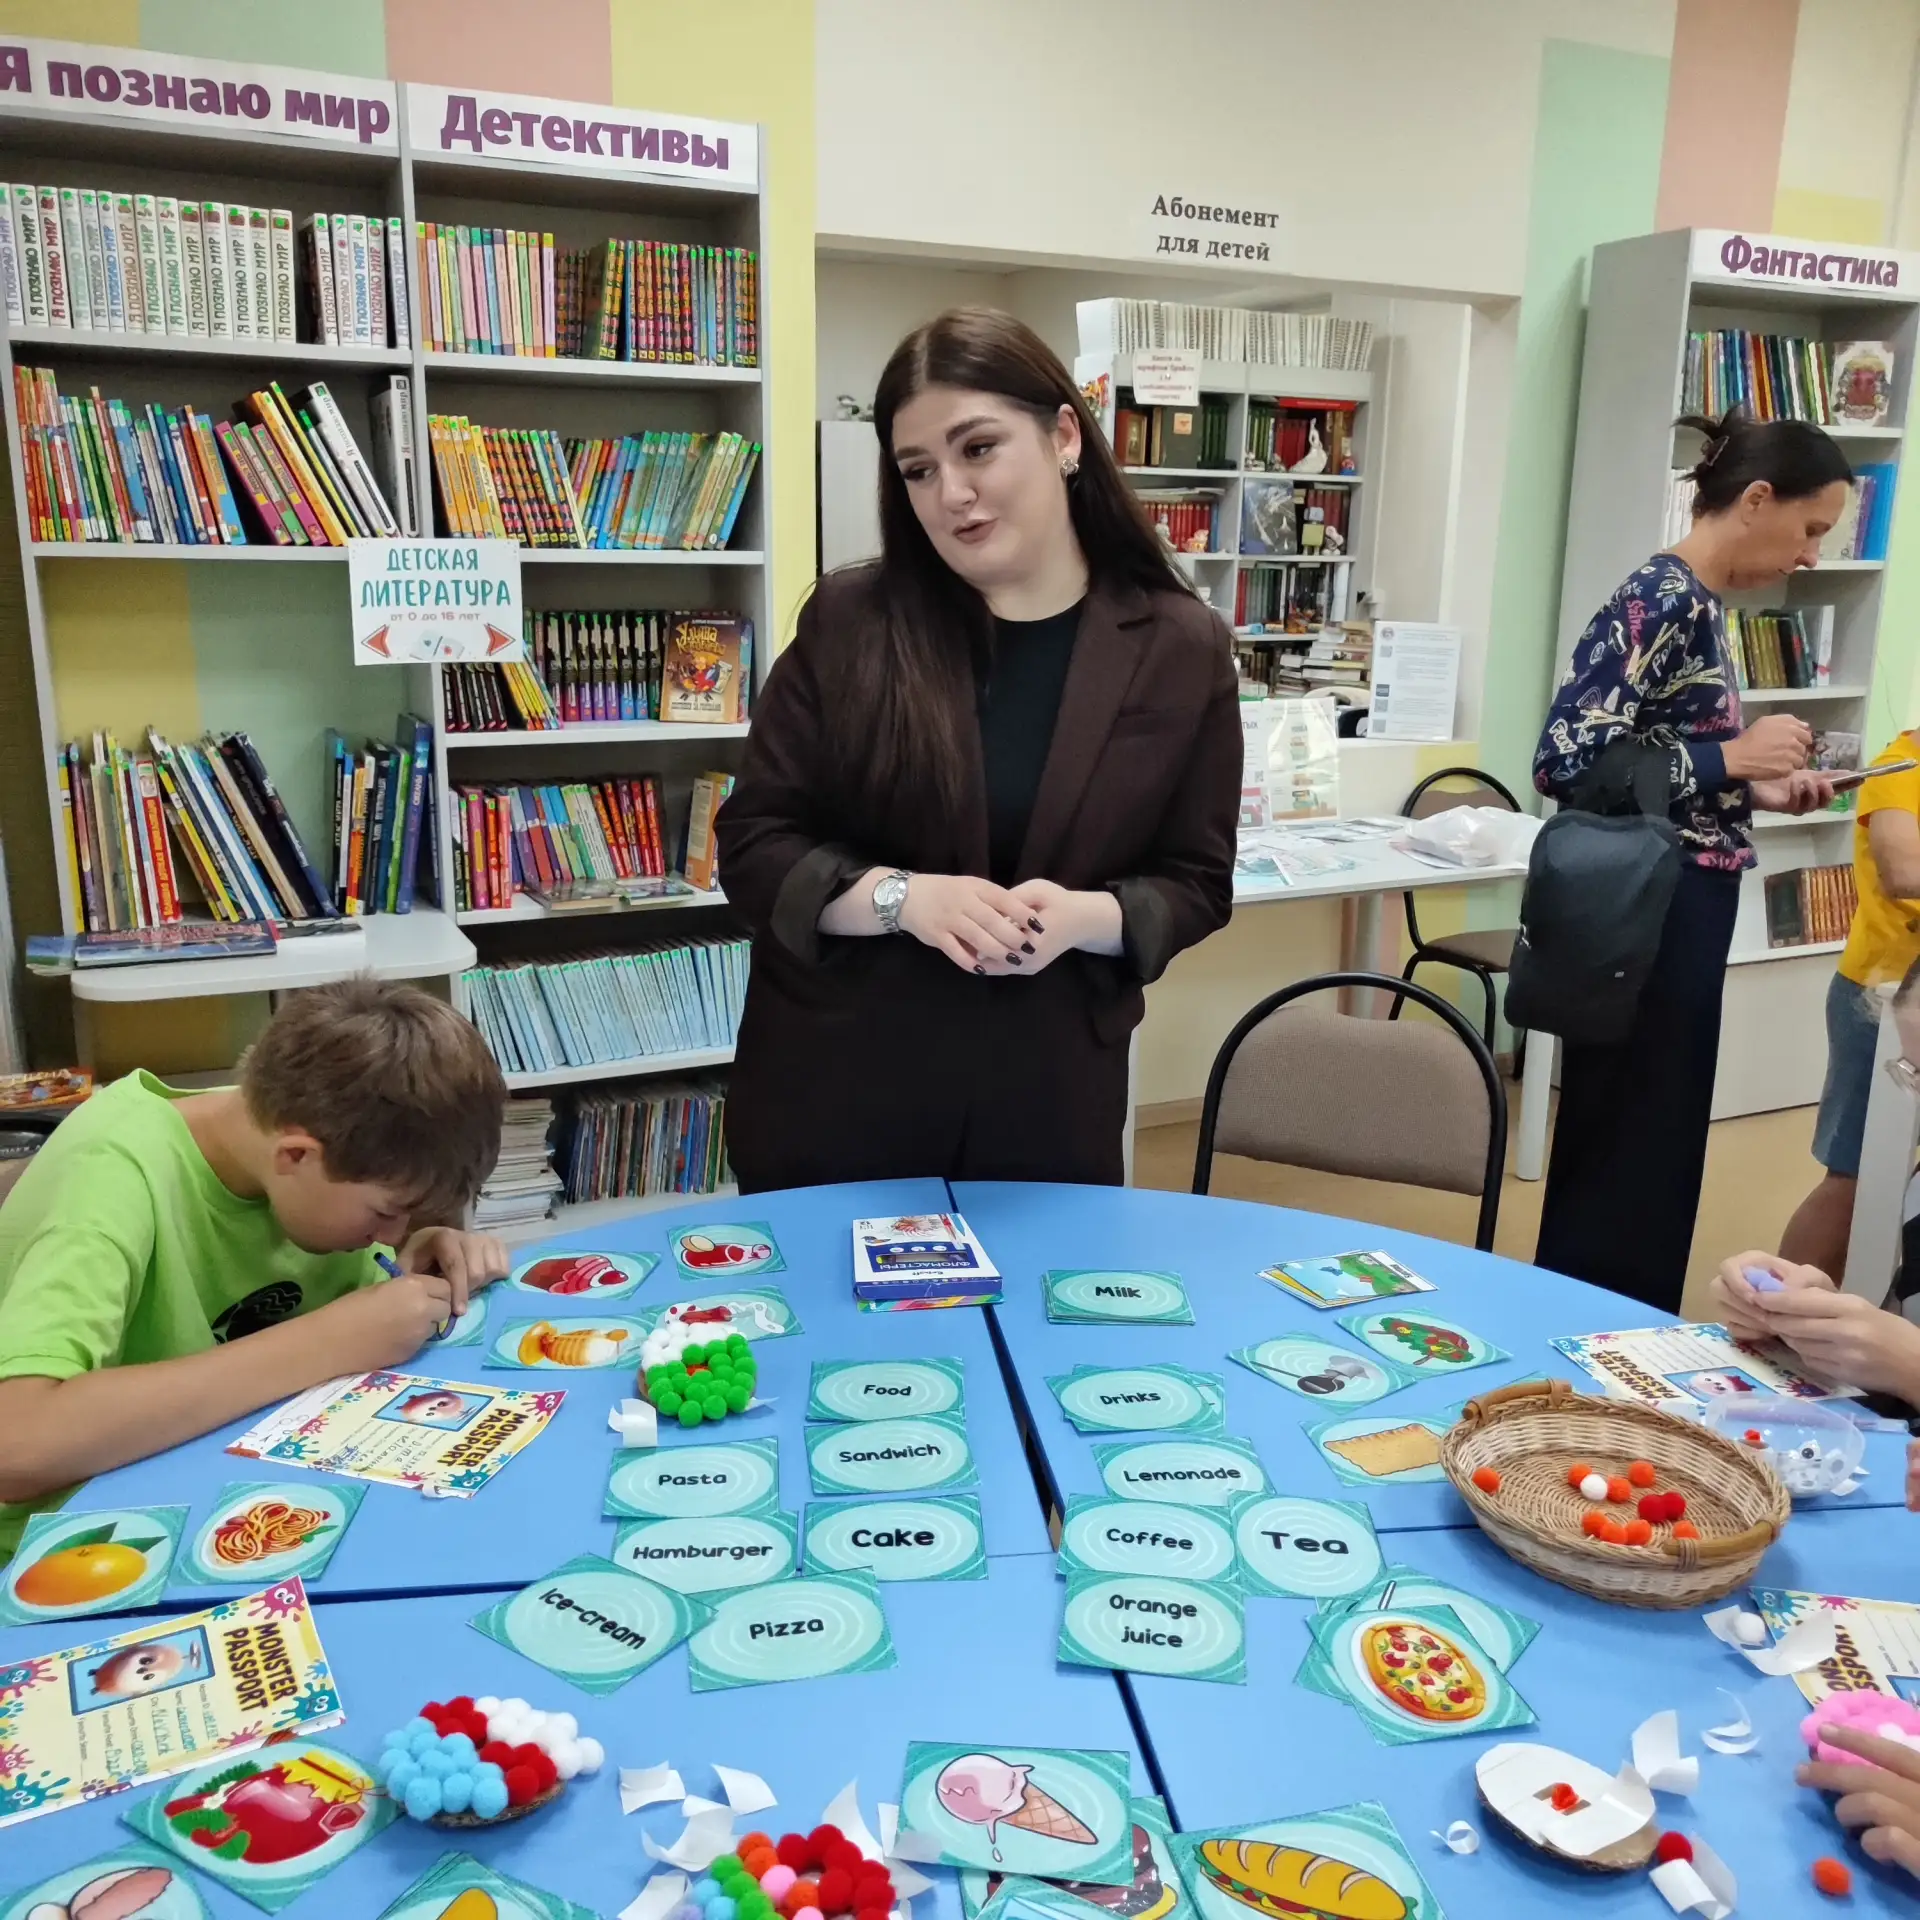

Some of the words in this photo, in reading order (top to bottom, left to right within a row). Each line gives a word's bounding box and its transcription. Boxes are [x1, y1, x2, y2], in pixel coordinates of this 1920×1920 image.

[0, 45, 30, 93] Я
[48, 61, 271, 120] познаю
[285, 86, 391, 144] мир
[440, 95, 730, 171] Детективы
[1151, 194, 1279, 230] Абонемент
[1156, 233, 1199, 255] для
[1206, 240, 1270, 261] детей
[1720, 234, 1899, 288] Фантастика
[189, 266, 205, 318] ПОЗНАЮ
[211, 267, 225, 319] ПОЗНАЮ
[235, 270, 250, 322] ПОЗНАЮ
[255, 272, 269, 323] ПОЗНАЮ
[277, 273, 291, 324] ПОЗНАЮ
[52, 308, 65, 319] Я
[191, 321, 205, 331] Я
[213, 322, 227, 332] Я
[237, 324, 251, 334] Я
[257, 325, 270, 335] Я
[279, 326, 291, 336] Я
[387, 548, 479, 571] ДЕТСКАЯ
[361, 579, 511, 608] ЛИТЕРАТУРА
[391, 614, 403, 622] от
[422, 613, 437, 621] до
[458, 612, 480, 621] лет
[1095, 1286, 1142, 1300] Milk
[1590, 1352, 1661, 1399] MONSTER
[1602, 1349, 1681, 1399] PASSPORT
[863, 1383, 912, 1398] Food
[1099, 1389, 1161, 1407] Drinks
[436, 1408, 511, 1467] PASSPORT
[465, 1412, 529, 1469] MONSTER
[839, 1444, 941, 1464] Sandwich
[657, 1472, 727, 1487] Pasta
[1123, 1467, 1242, 1483] Lemonade
[632, 1542, 774, 1561] Hamburger
[851, 1528, 935, 1549] Cake
[1106, 1527, 1194, 1551] Coffee
[1261, 1529, 1349, 1556] Tea
[538, 1587, 646, 1651] Ice-cream
[1109, 1594, 1198, 1620] Orange
[749, 1616, 825, 1641] Pizza
[1121, 1625, 1183, 1649] juice
[223, 1627, 269, 1712] PASSPORT
[253, 1622, 298, 1702] MONSTER
[1834, 1625, 1881, 1693] SSPOR
